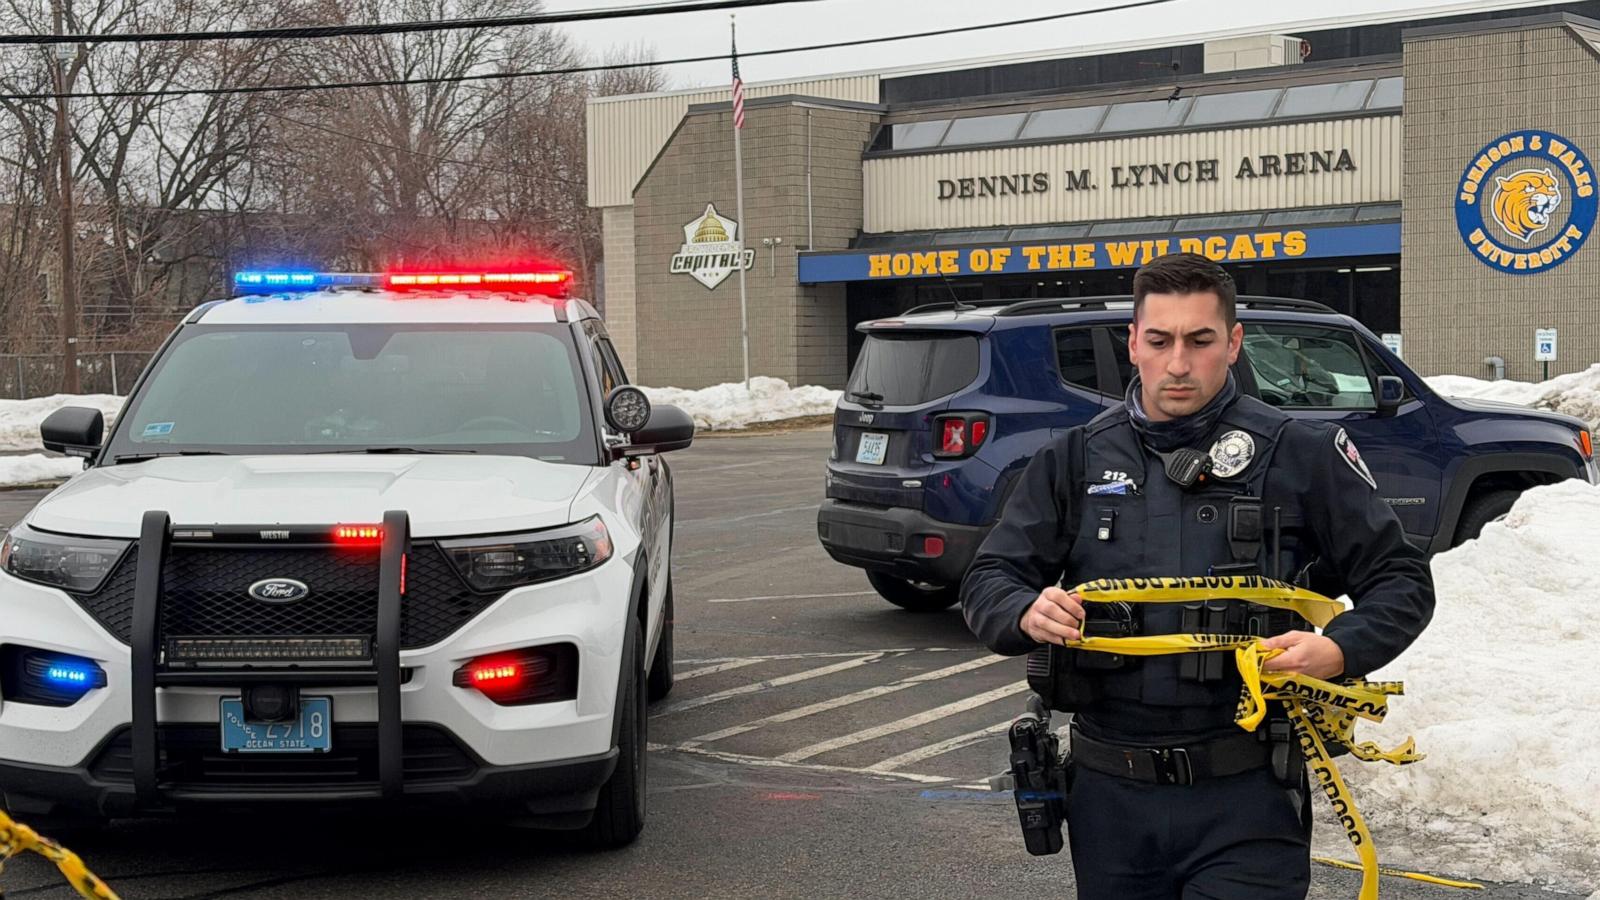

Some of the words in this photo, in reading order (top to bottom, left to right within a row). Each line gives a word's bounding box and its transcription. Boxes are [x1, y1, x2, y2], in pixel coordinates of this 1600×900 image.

[937, 172, 1049, 200] DENNIS
[1066, 169, 1097, 191] M.
[1111, 159, 1219, 188] LYNCH
[1236, 148, 1358, 180] ARENA
[1461, 136, 1525, 205] JOHNSON
[1529, 135, 1542, 150] &
[1548, 139, 1593, 197] WALES
[868, 249, 959, 277] HOME
[970, 248, 1011, 272] OF
[1022, 243, 1096, 270] THE
[1469, 224, 1583, 269] UNIVERSITY
[1102, 470, 1127, 482] 212
[260, 530, 289, 539] WESTIN
[262, 583, 295, 597] Ford
[227, 712, 257, 739] POLICE
[246, 740, 274, 748] OCEAN
[279, 740, 306, 748] STATE
